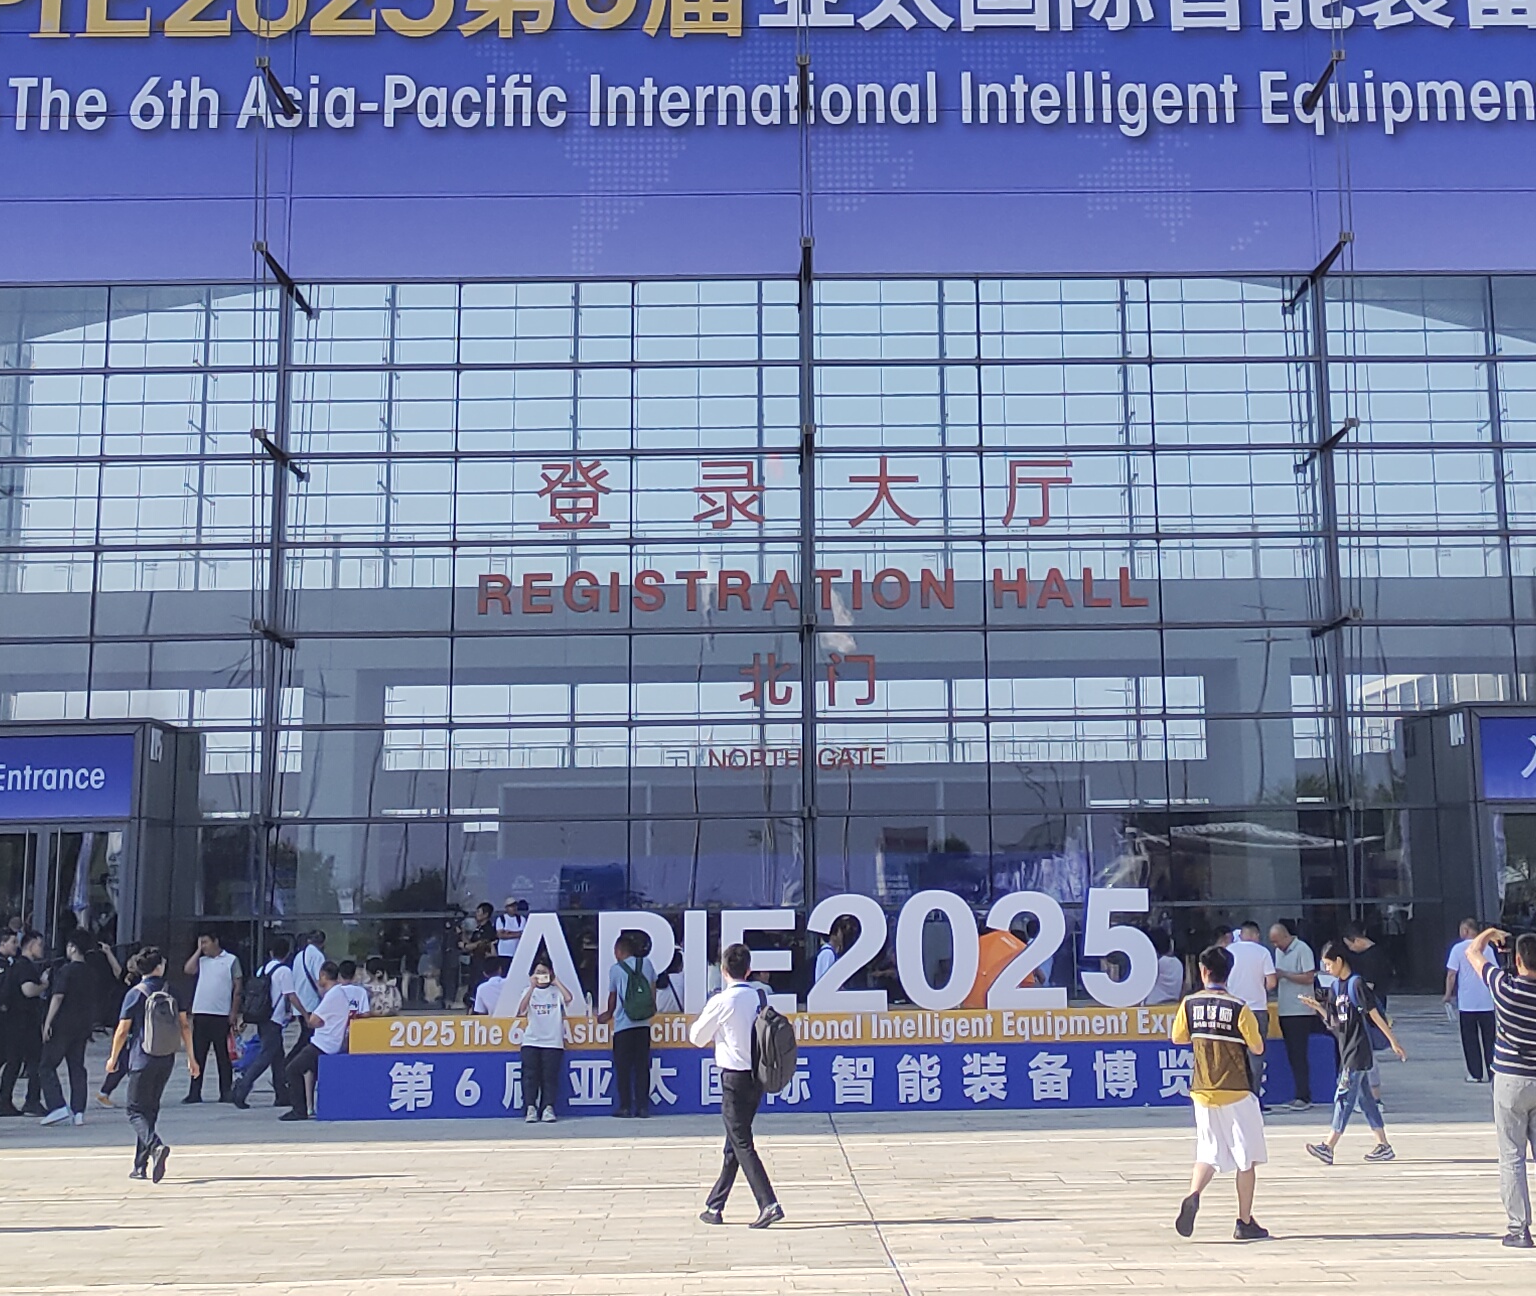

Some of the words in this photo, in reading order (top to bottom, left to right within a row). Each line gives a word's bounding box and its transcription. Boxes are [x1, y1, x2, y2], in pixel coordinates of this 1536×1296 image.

[16, 75, 107, 132] The
[131, 73, 219, 130] 6th
[236, 71, 568, 132] Asia-Pacific
[589, 69, 938, 128] International
[960, 67, 1238, 138] Intelligent
[477, 567, 955, 616] REGISTRATION
[992, 566, 1150, 609] HALL
[738, 652, 879, 707] 北门
[708, 747, 802, 771] NORTH
[817, 747, 886, 771] GATE
[491, 888, 1159, 1018] APIE2025
[389, 1020, 456, 1048] 2025
[461, 1019, 504, 1046] The
[871, 1011, 994, 1043] Intelligent
[1002, 1010, 1128, 1042] Equipment
